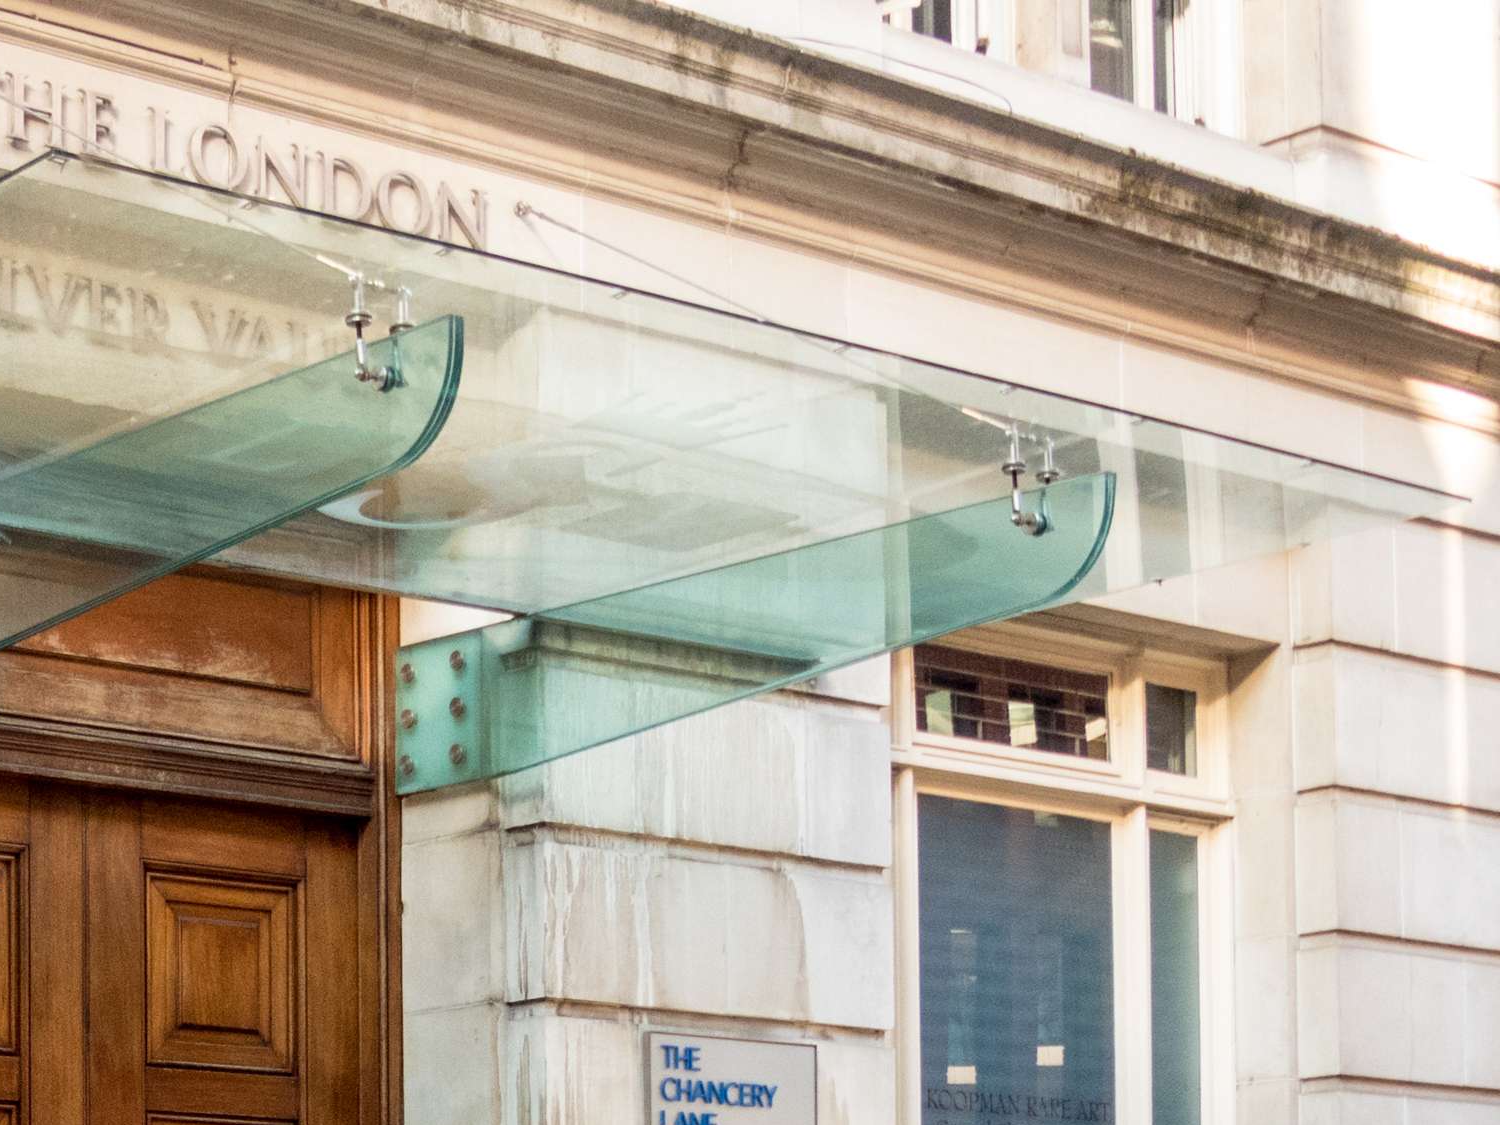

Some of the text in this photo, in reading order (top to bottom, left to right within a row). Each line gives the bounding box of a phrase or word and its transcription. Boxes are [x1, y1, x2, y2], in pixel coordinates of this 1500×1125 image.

[145, 104, 490, 252] LONDON
[660, 1045, 701, 1072] THE
[660, 1077, 778, 1108] CHANCERY
[926, 1089, 1110, 1123] KOOPMAN RARE ART
